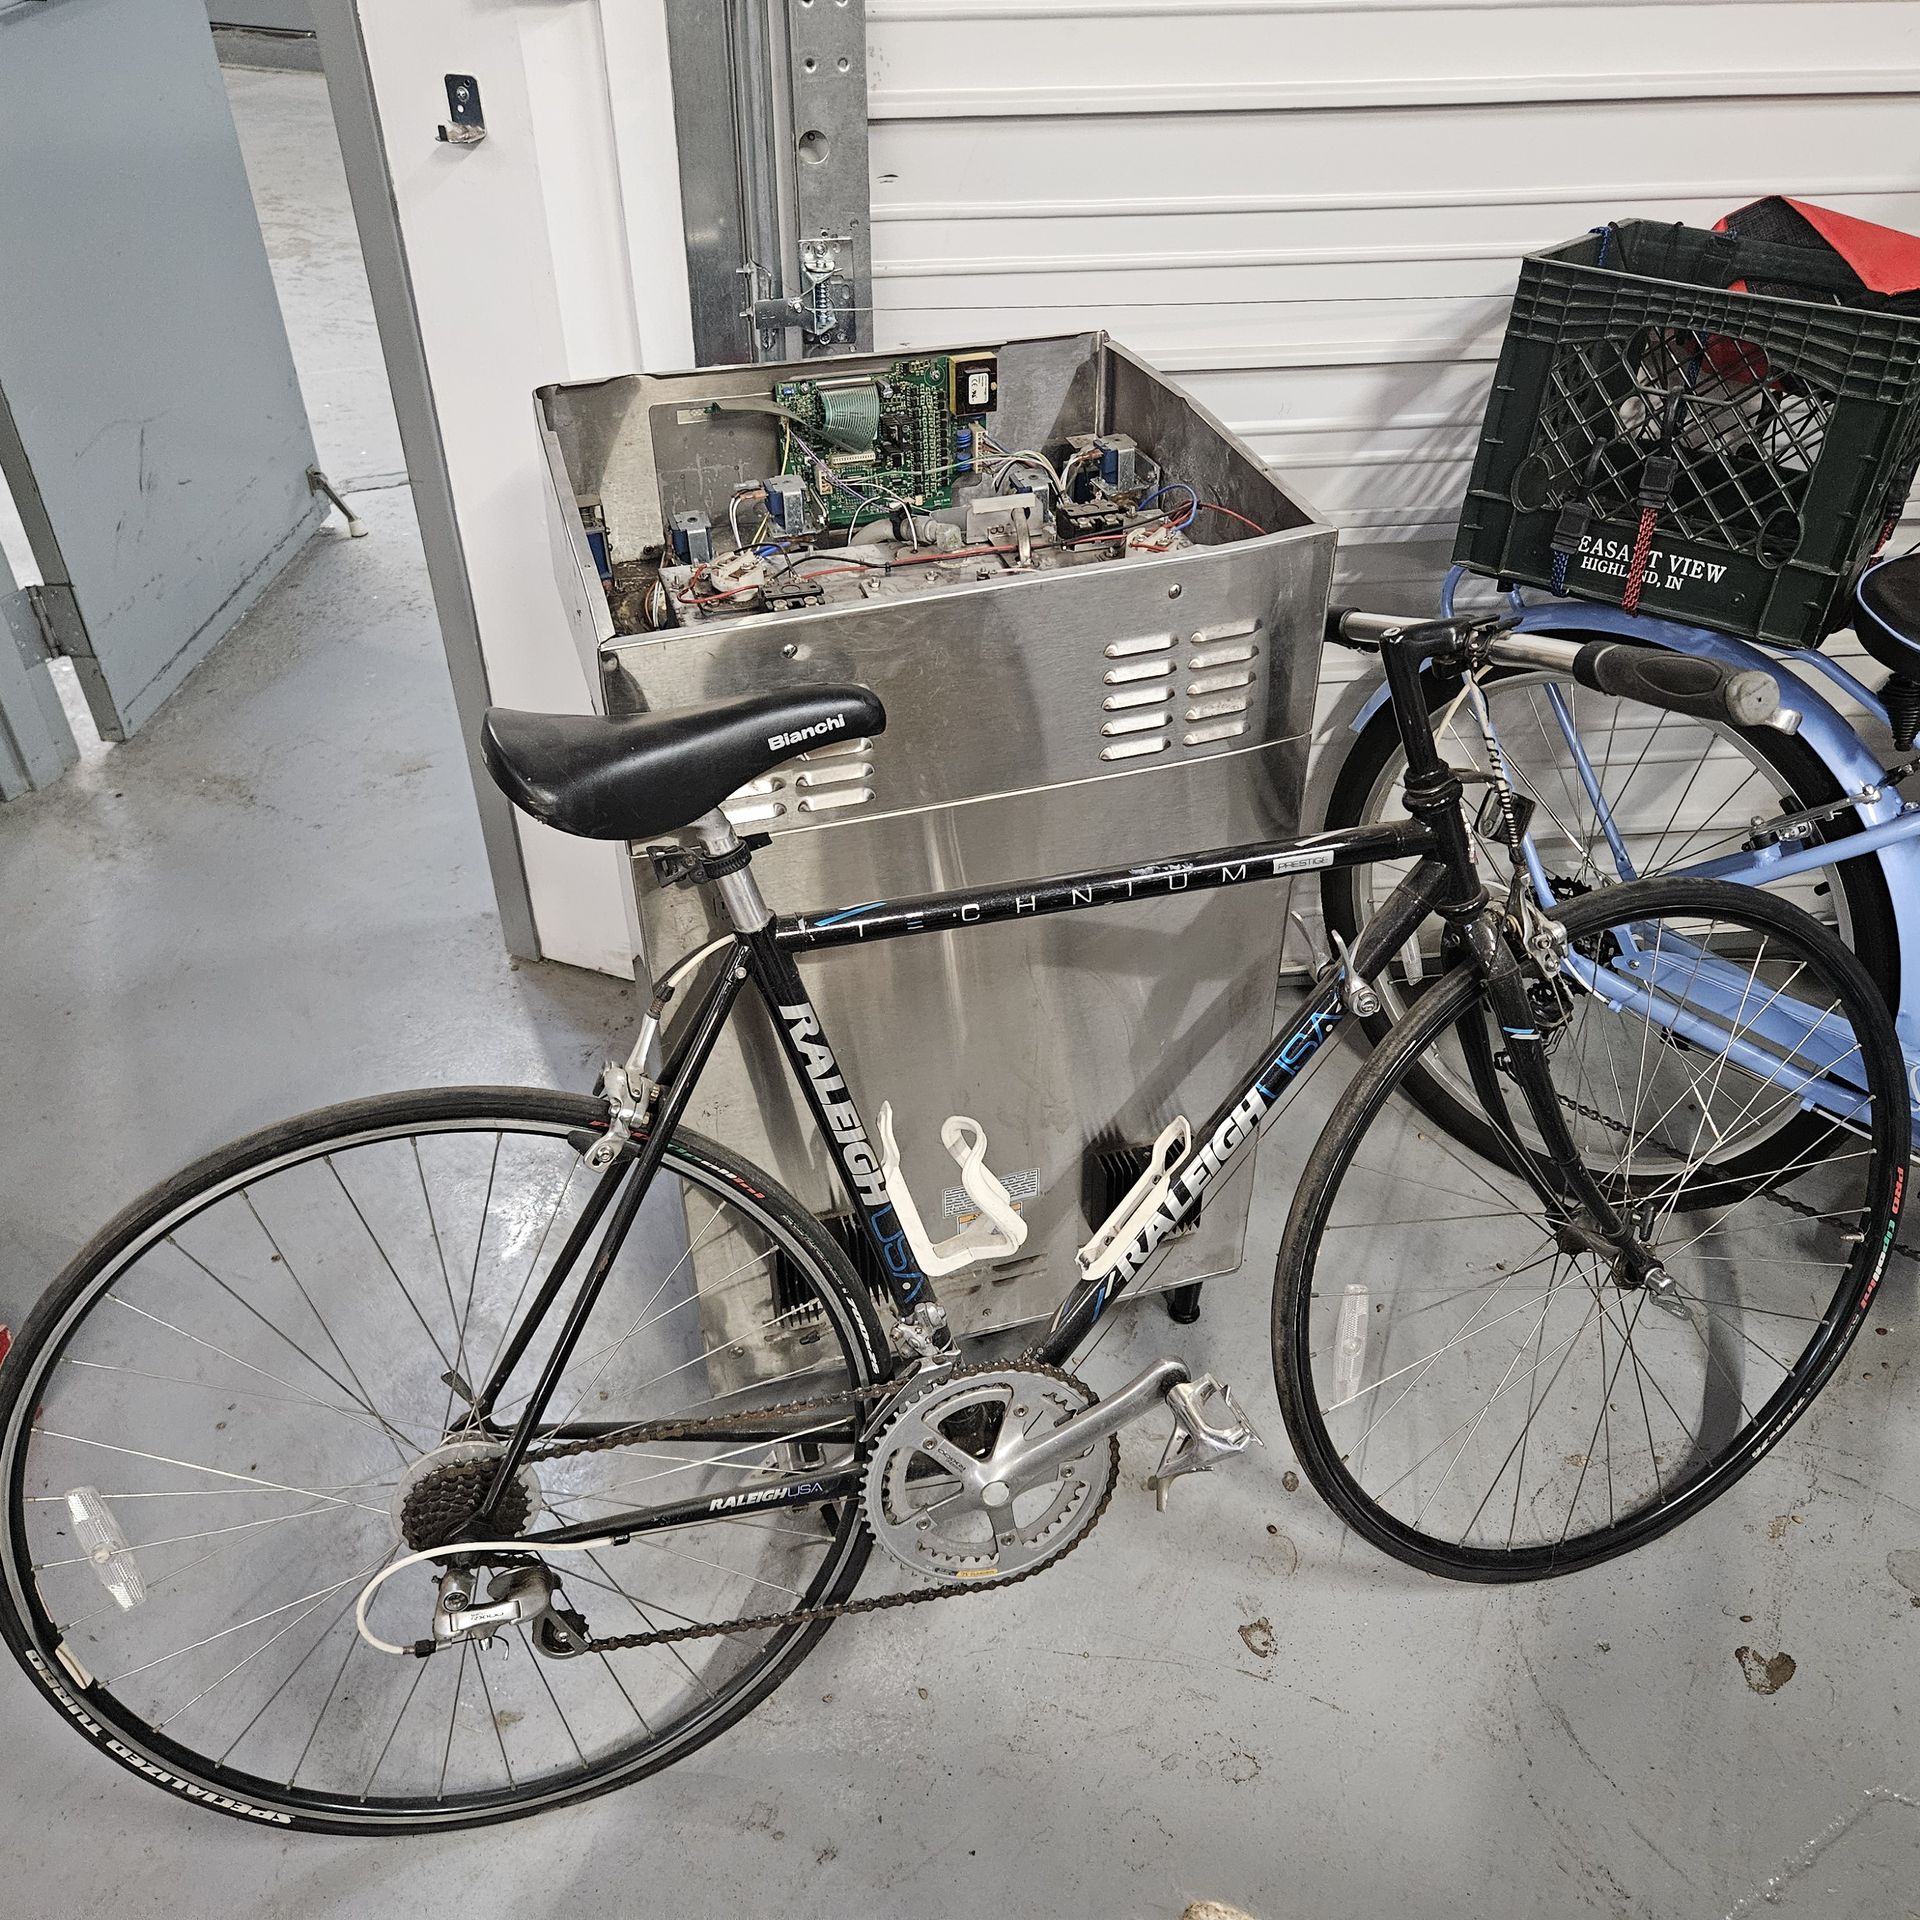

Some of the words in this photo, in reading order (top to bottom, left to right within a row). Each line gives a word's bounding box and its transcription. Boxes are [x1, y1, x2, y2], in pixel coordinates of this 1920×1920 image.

[1578, 535, 1662, 569] EASAT
[1669, 554, 1727, 584] VIEW
[1580, 556, 1661, 588] HIGHLND,
[1664, 575, 1684, 591] IN
[768, 713, 846, 752] Bianchi
[1278, 856, 1330, 874] PRESTIGE
[25, 1649, 103, 1737] TURBO
[106, 1739, 296, 1824] SPECIALIZED
